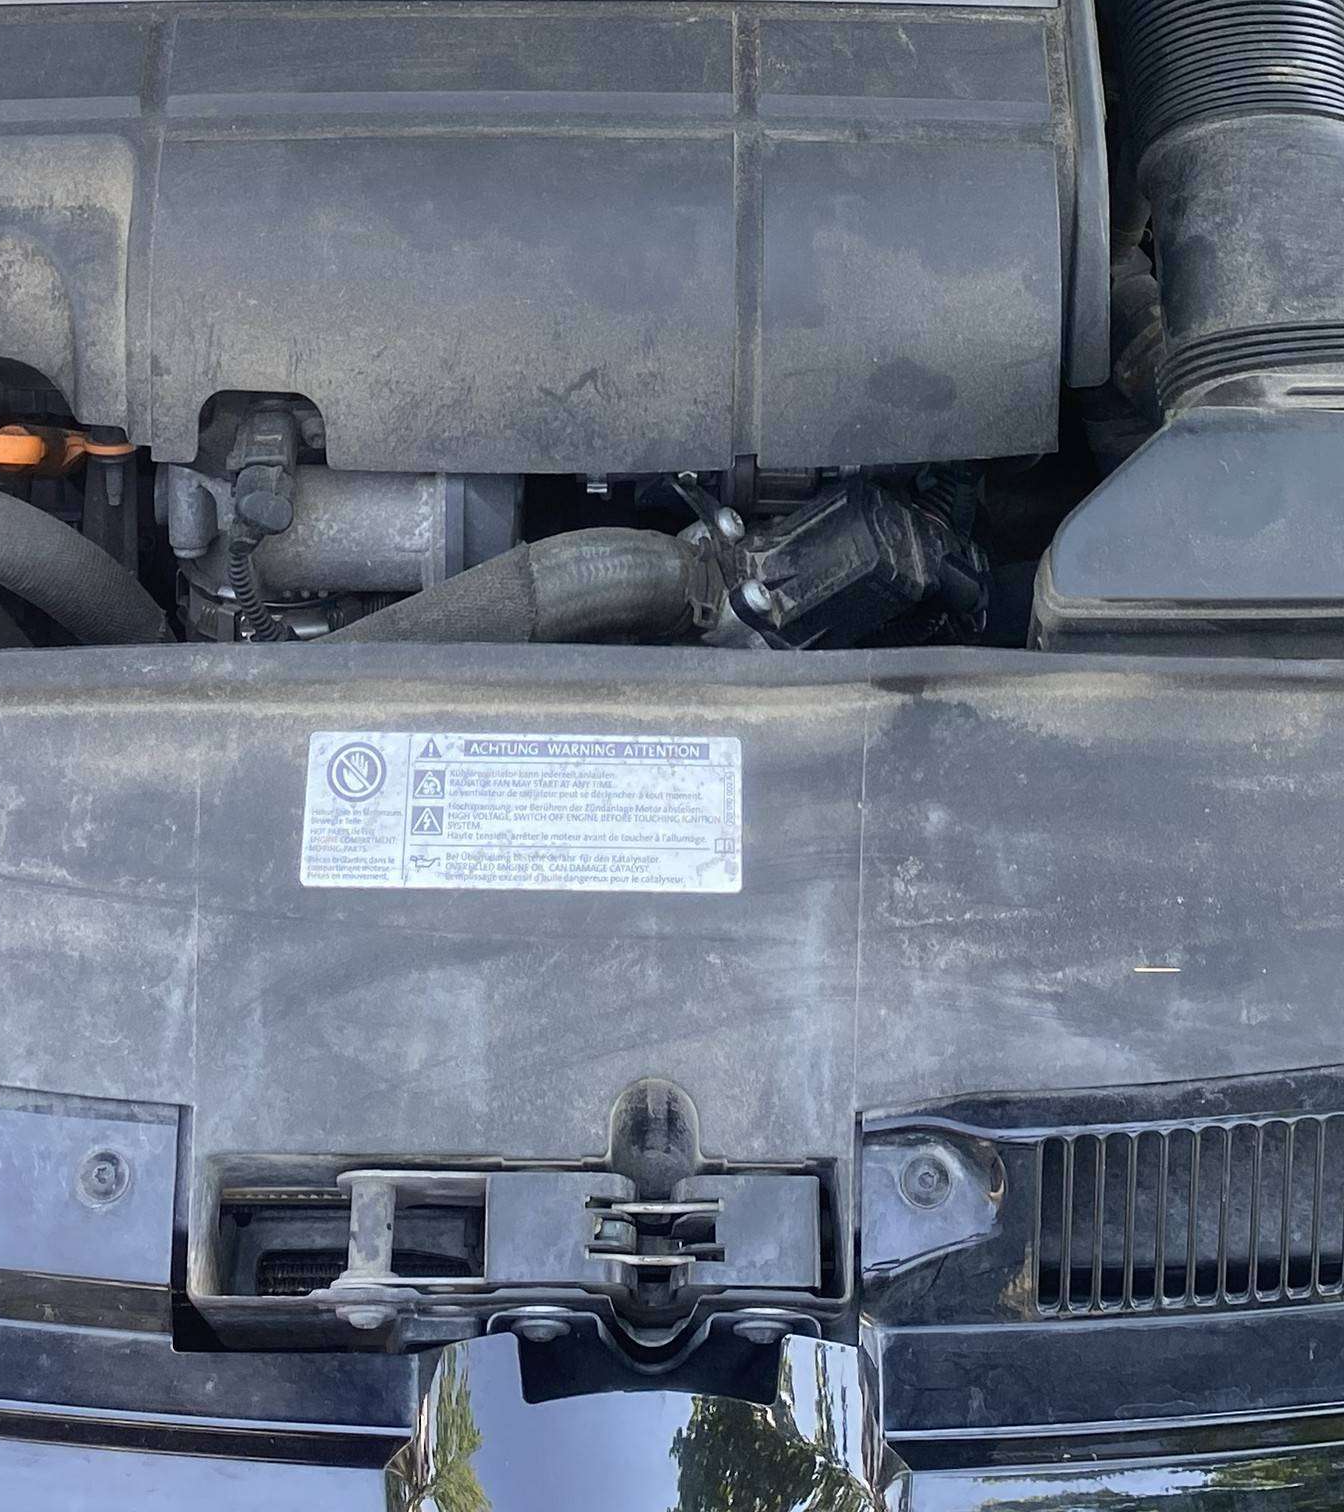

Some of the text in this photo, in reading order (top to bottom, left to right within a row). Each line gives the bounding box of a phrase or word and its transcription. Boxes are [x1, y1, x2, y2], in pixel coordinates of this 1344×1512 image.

[470, 743, 700, 758] ACHTUNG WARNING ATTENTION
[493, 780, 510, 788] FAN
[512, 780, 530, 788] MAY
[534, 780, 557, 788] START
[560, 780, 570, 788] AT
[560, 792, 578, 800] peut
[569, 805, 583, 813] der
[635, 806, 661, 814] Motor
[448, 812, 471, 820] HIGH
[513, 813, 547, 821] SWITCH
[548, 813, 564, 821] OFF
[566, 814, 598, 822] ENGINE
[600, 814, 632, 822] BEFORE
[634, 815, 680, 823] TOUCHING
[682, 815, 720, 823] IGNITION
[447, 832, 472, 840] Haute
[541, 833, 549, 841] le
[583, 833, 606, 841] avant
[608, 834, 619, 842] de
[580, 854, 593, 863] für
[594, 854, 610, 862] den
[548, 864, 568, 872] CAN
[570, 865, 607, 873] DAMAGE
[610, 877, 629, 885] pour
